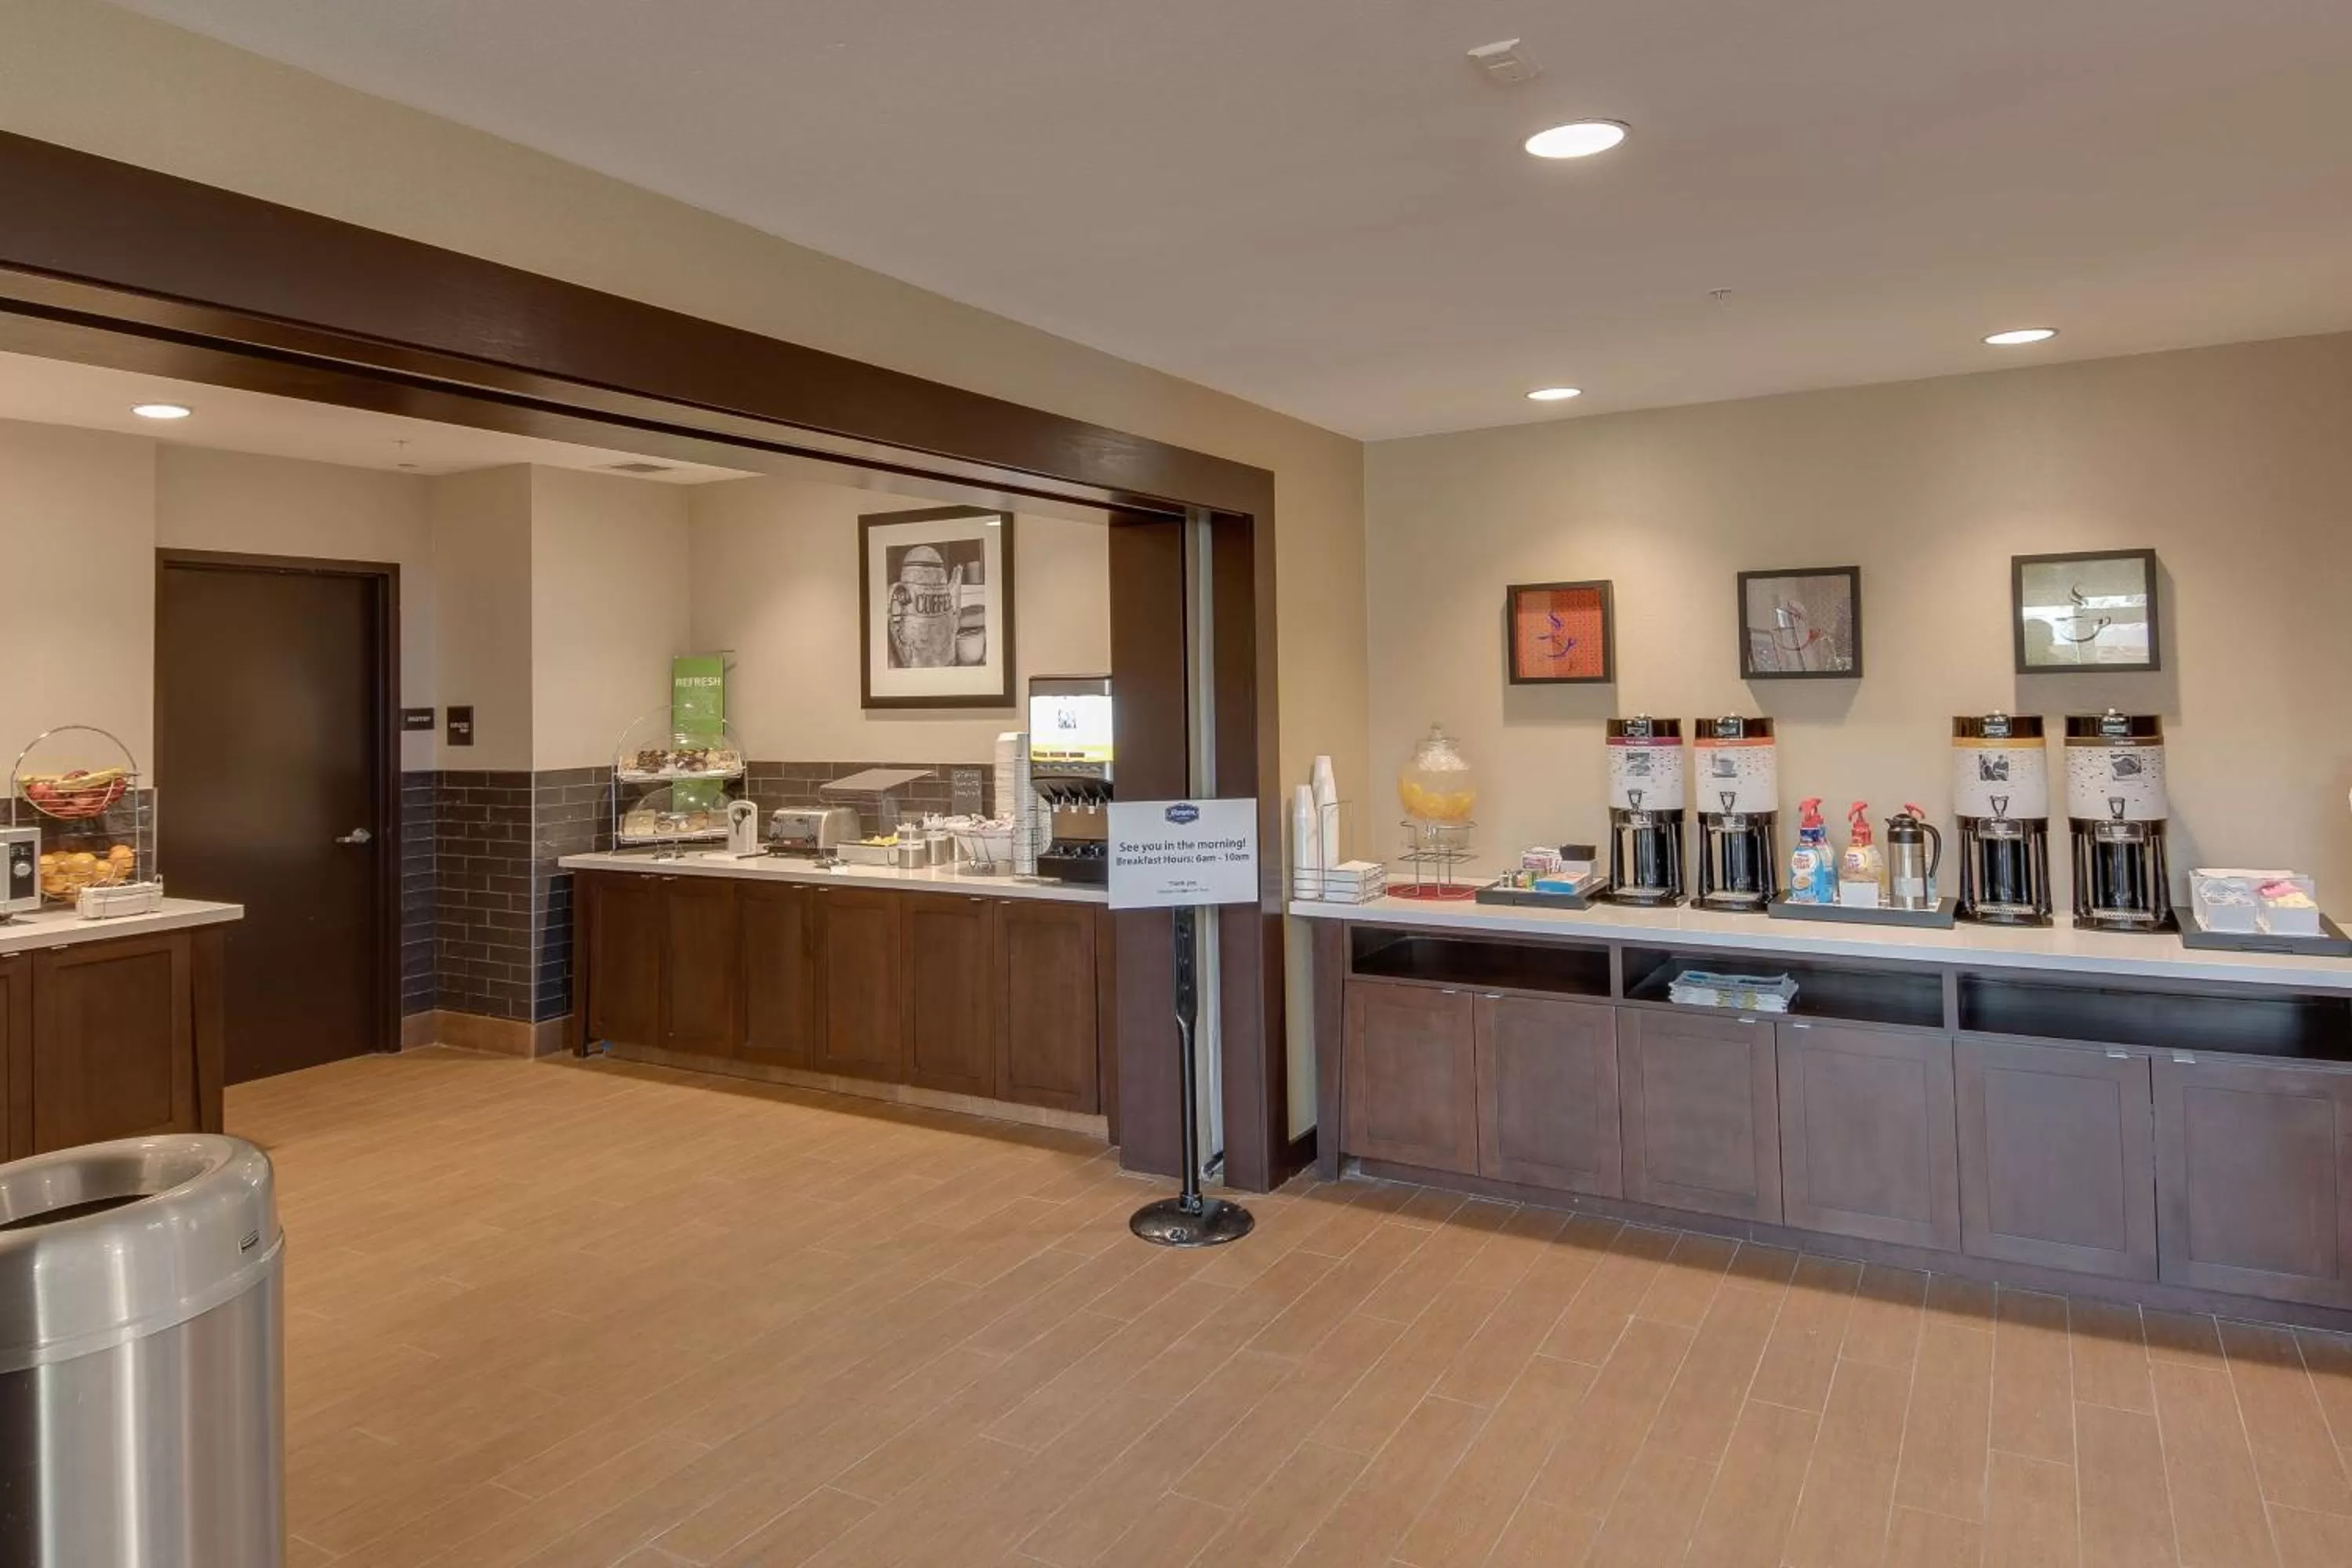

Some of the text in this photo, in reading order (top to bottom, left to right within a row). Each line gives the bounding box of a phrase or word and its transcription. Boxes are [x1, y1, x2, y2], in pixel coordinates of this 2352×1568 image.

[916, 593, 952, 613] COFFEE
[675, 677, 720, 687] REFRESH
[1119, 837, 1246, 853] See you in the morning!
[1116, 855, 1161, 866] Breakfast
[1163, 855, 1194, 864] Hours:
[1196, 854, 1216, 863] 6am
[1225, 852, 1250, 862] 10am
